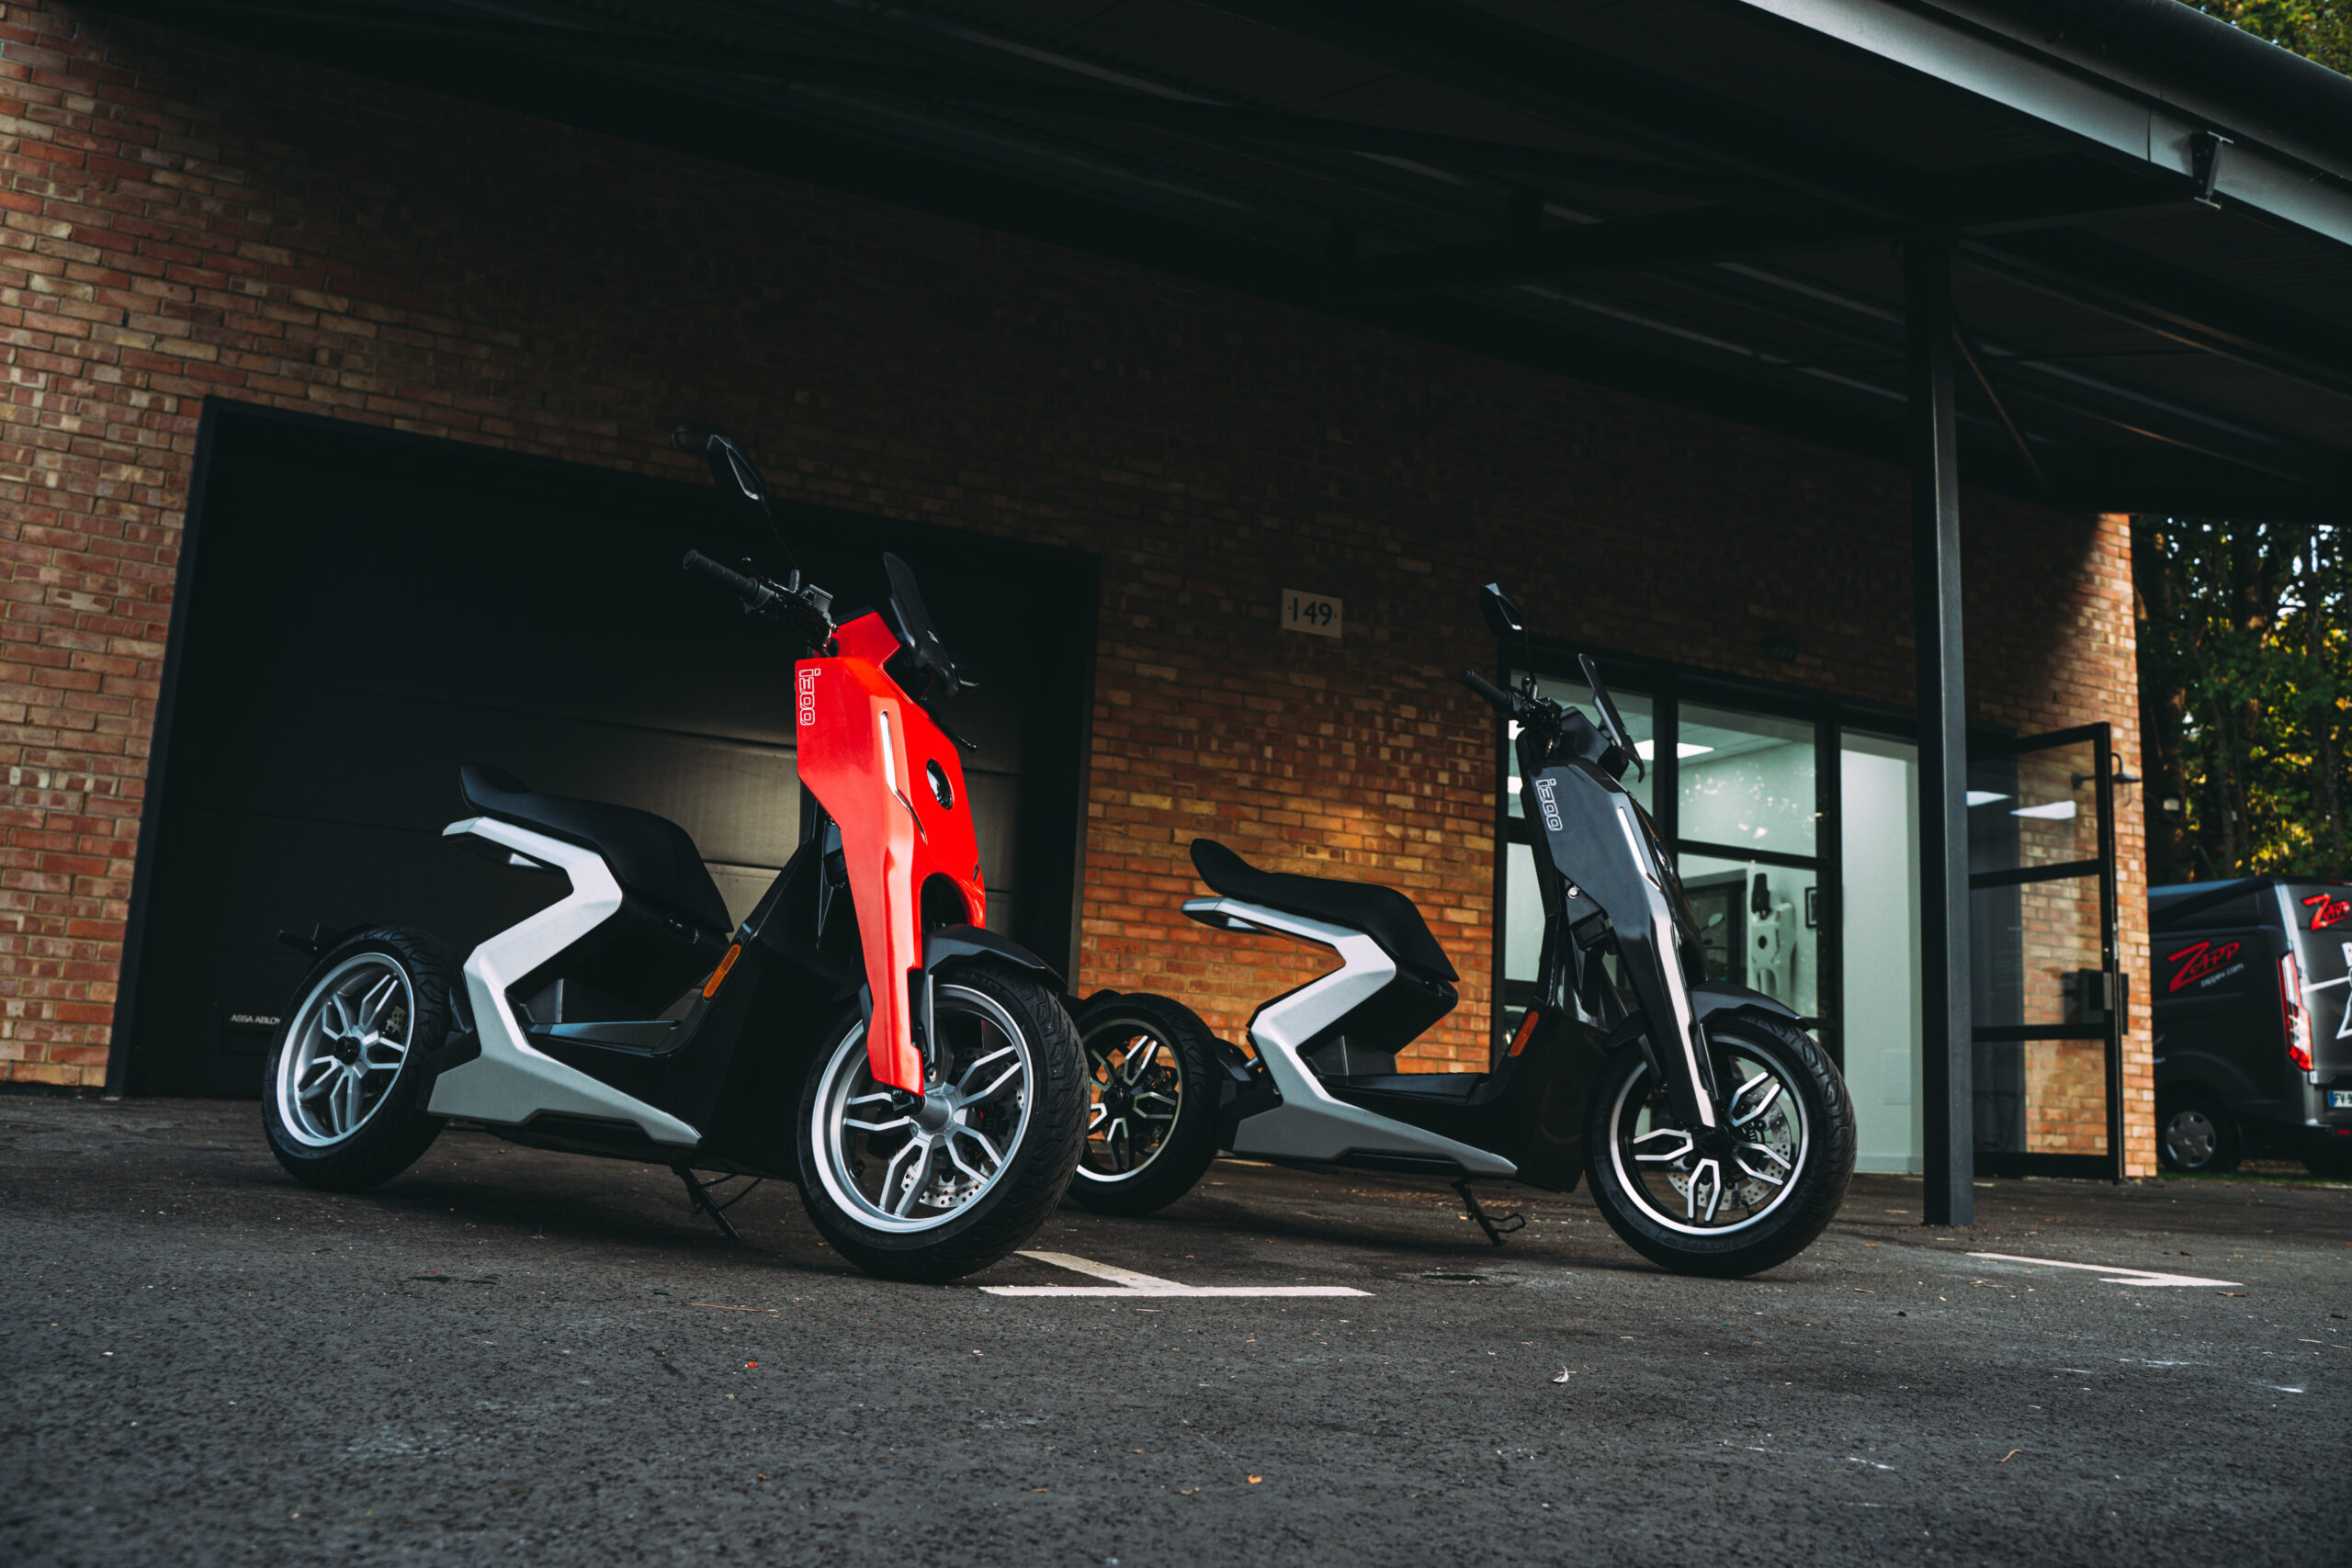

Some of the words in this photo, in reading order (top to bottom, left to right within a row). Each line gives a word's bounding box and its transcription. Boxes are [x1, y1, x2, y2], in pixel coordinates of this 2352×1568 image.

[1293, 597, 1332, 626] 149
[231, 1014, 254, 1023] ASSA
[254, 1015, 281, 1025] ABLOY
